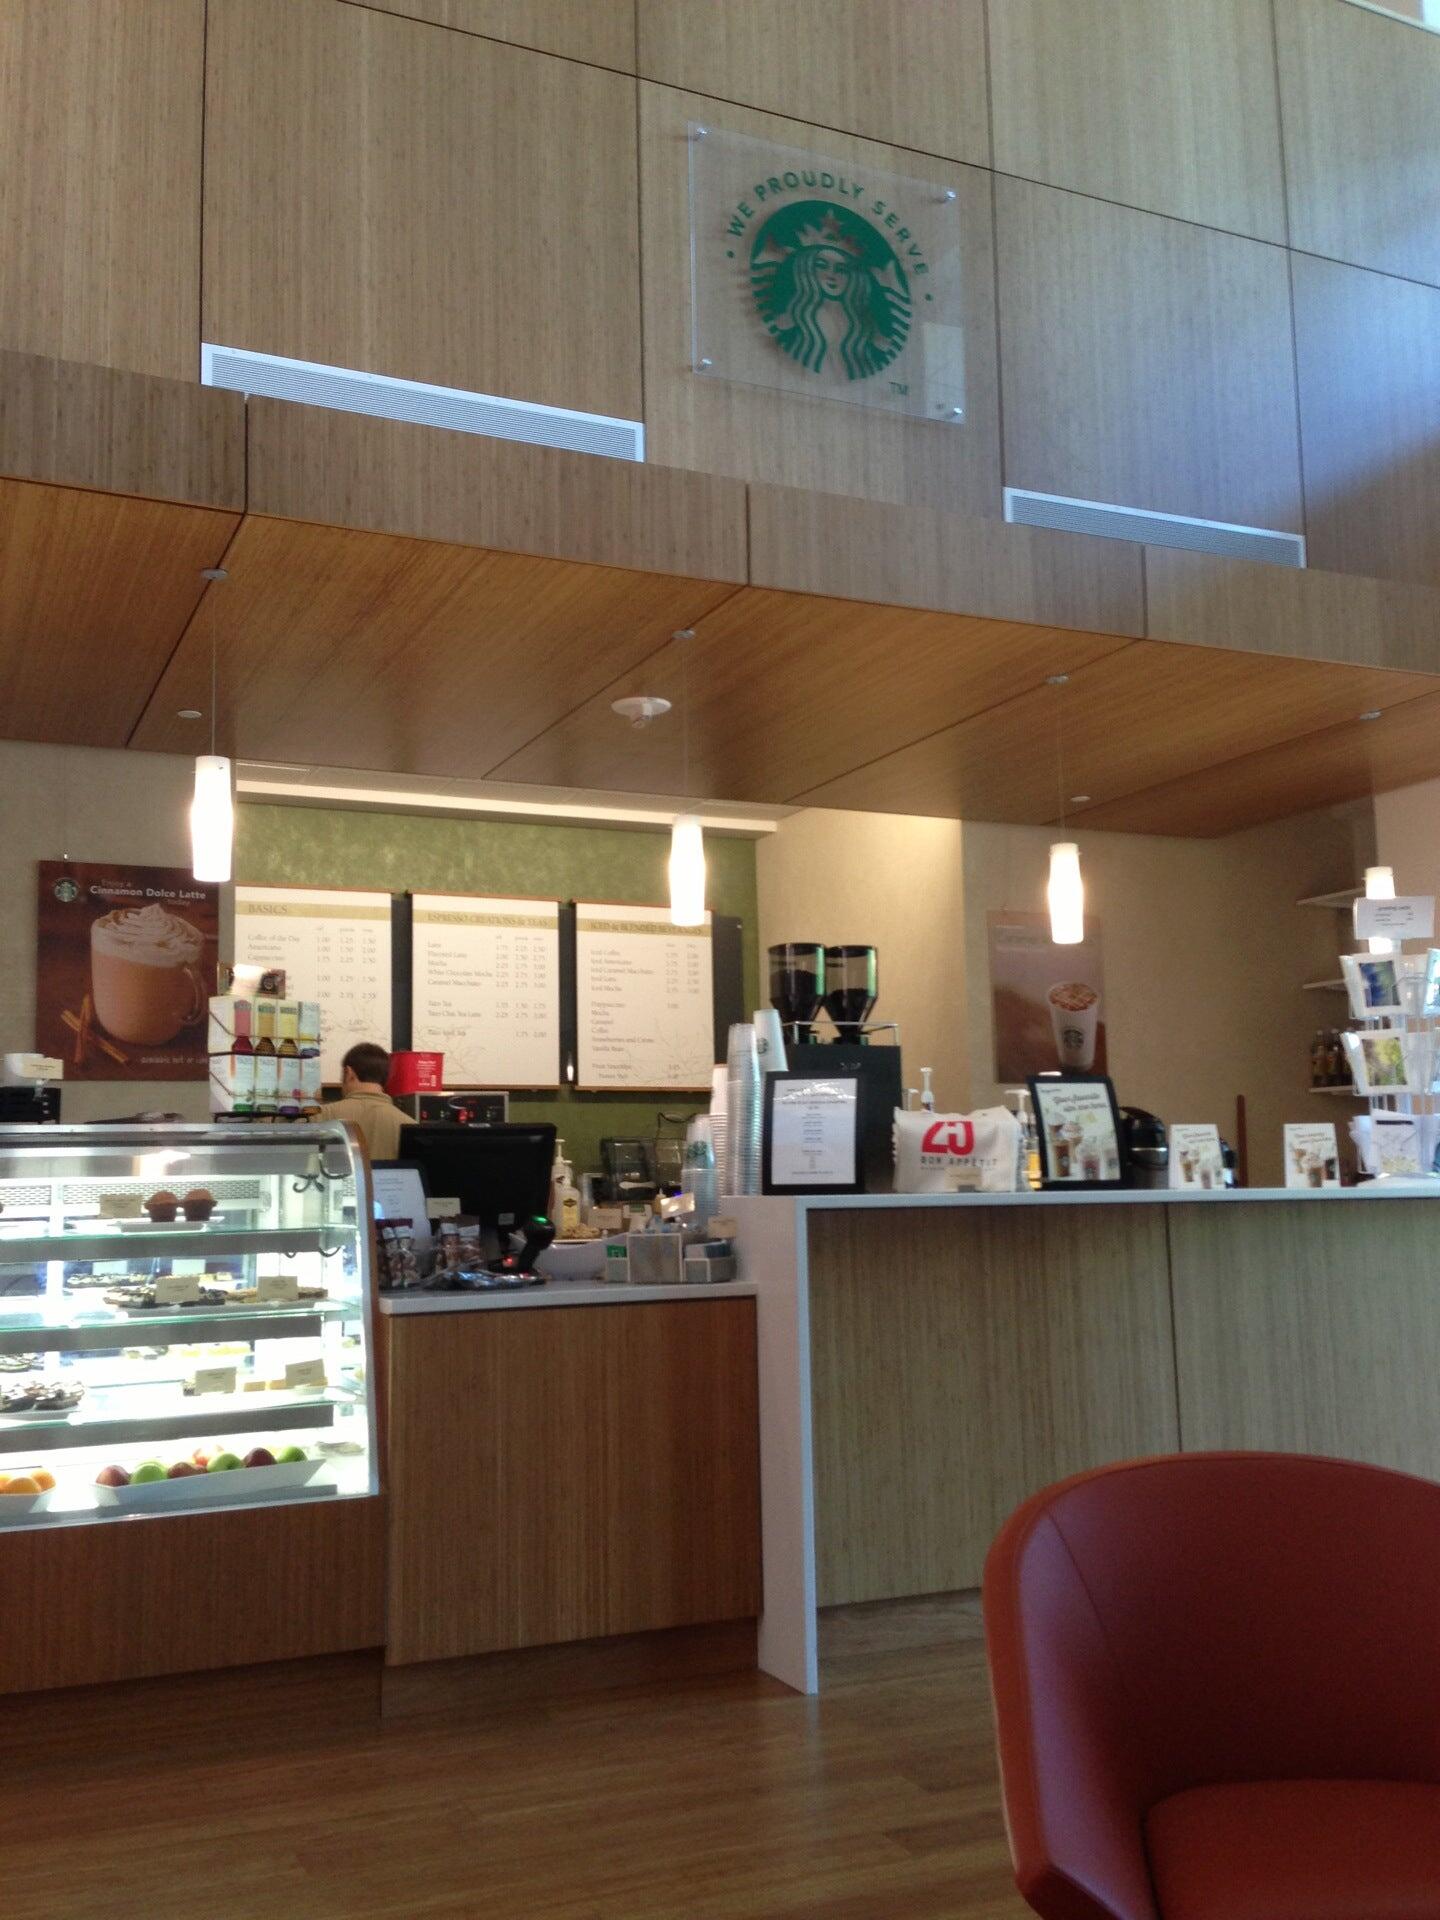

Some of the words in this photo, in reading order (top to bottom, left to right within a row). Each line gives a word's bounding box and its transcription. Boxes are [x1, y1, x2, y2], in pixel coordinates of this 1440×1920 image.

[727, 201, 756, 239] WE
[753, 169, 865, 201] PROUDLY
[871, 200, 930, 276] SERVE
[90, 885, 143, 897] Cinnamon
[146, 888, 176, 898] Dolce
[179, 890, 206, 900] Latte
[248, 904, 289, 915] BASICS
[920, 1156, 942, 1165] BON
